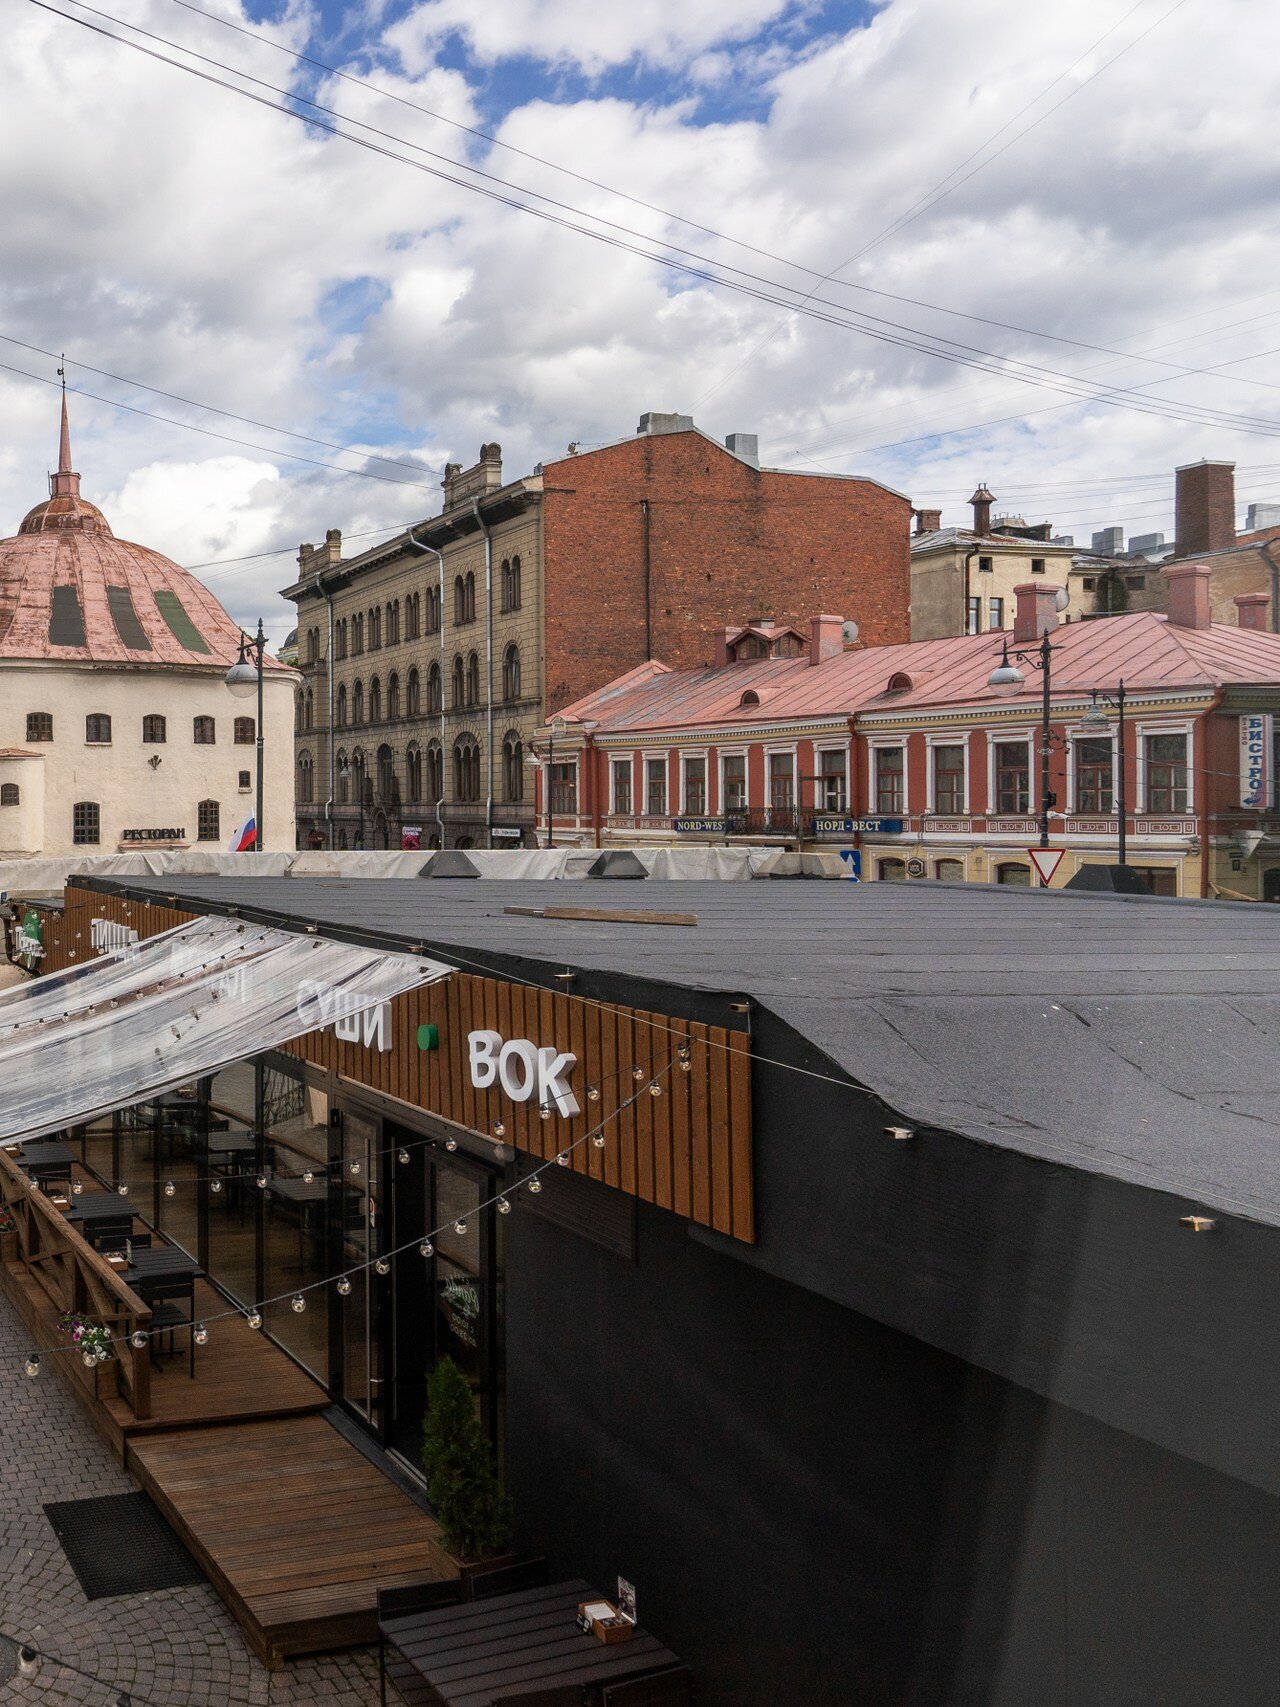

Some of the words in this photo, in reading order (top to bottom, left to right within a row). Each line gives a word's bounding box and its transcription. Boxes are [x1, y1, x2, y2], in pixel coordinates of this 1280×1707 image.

[1249, 718, 1263, 790] БИСТРО
[123, 828, 186, 840] РЕСТОРАН
[467, 1029, 580, 1119] ВОК
